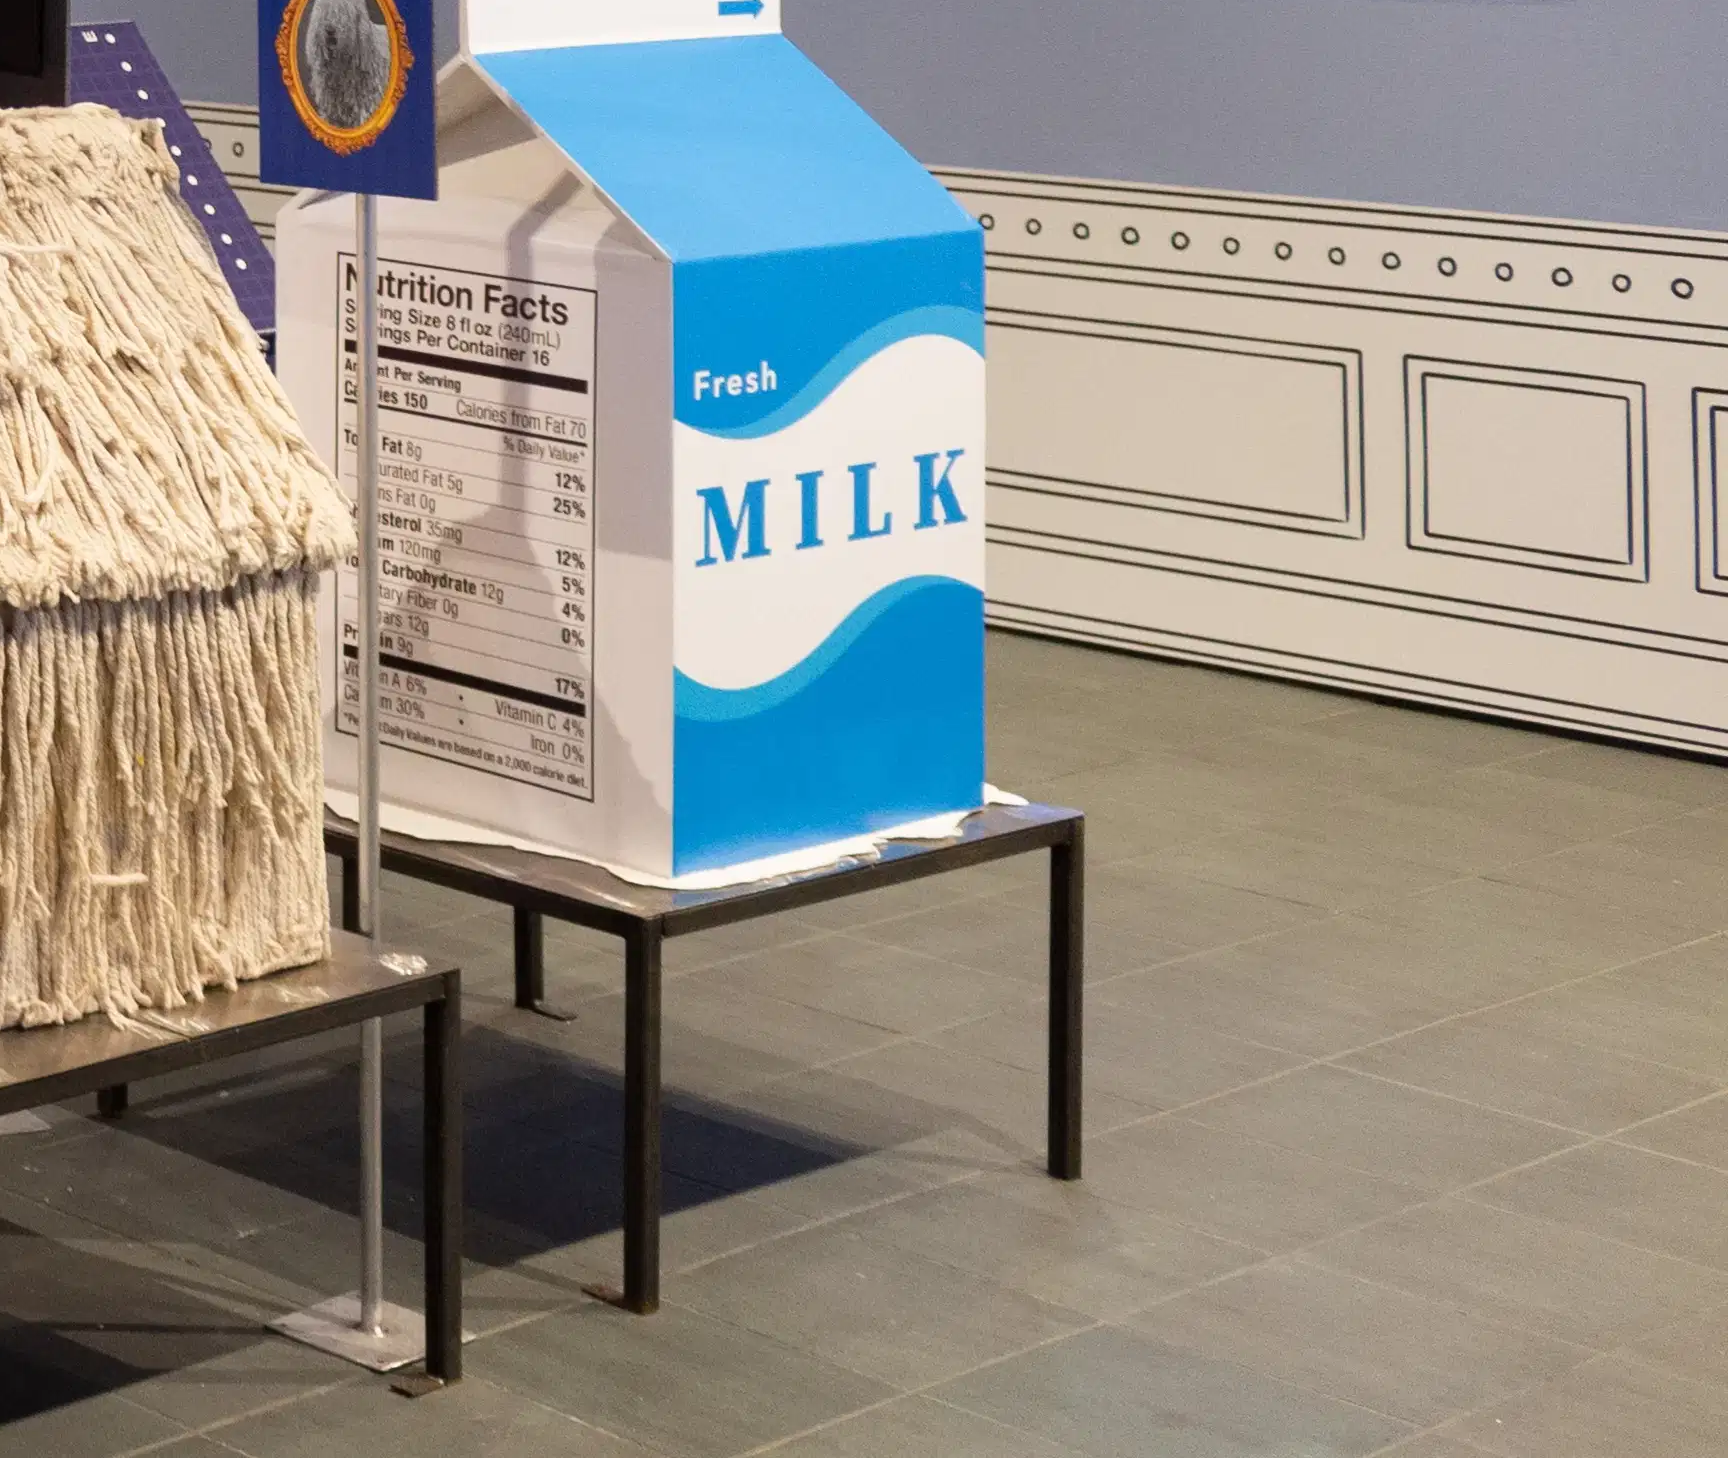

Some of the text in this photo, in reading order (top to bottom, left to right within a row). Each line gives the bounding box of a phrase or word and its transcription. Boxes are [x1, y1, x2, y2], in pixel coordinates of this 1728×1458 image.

[345, 262, 569, 326] Ntrition Facts
[344, 317, 550, 367] Sings Per Container 16
[345, 298, 561, 351] Sing Size 8 fl oz (240mL)
[394, 364, 413, 382] Per
[417, 370, 462, 394] Serving
[694, 360, 778, 401] Fresh
[404, 391, 428, 410] 150
[456, 399, 508, 425] Calories
[511, 410, 541, 430] from
[545, 416, 566, 435] Fat
[570, 420, 586, 439] 70
[382, 435, 403, 456] Fat
[405, 439, 422, 461] 8g
[554, 470, 586, 492] 12%
[503, 434, 516, 452] %
[517, 438, 545, 459] Daily
[395, 489, 416, 508] Fat
[419, 493, 436, 514] 0g
[422, 469, 444, 489] Fat
[447, 474, 463, 494] 5g
[553, 497, 586, 519] 25%
[695, 448, 968, 567] MILK
[399, 540, 441, 565] 120mg
[562, 576, 585, 596] 5%
[426, 520, 463, 544] 35mg
[555, 549, 586, 570] 12%
[382, 559, 477, 595] Carbohydrate
[480, 582, 504, 605] 12g
[562, 602, 585, 622] 4%
[407, 589, 438, 611] Fiber
[442, 598, 459, 619] 0g
[561, 627, 585, 648] 0%
[408, 615, 430, 636] 12g
[397, 637, 414, 658] 9g
[554, 678, 585, 700] 17%
[392, 672, 401, 690] A
[406, 676, 428, 696] 6%
[494, 699, 544, 726] Vitamin
[547, 712, 557, 731] C
[562, 717, 585, 739] 4%
[396, 699, 585, 764] 30% Iron 0%
